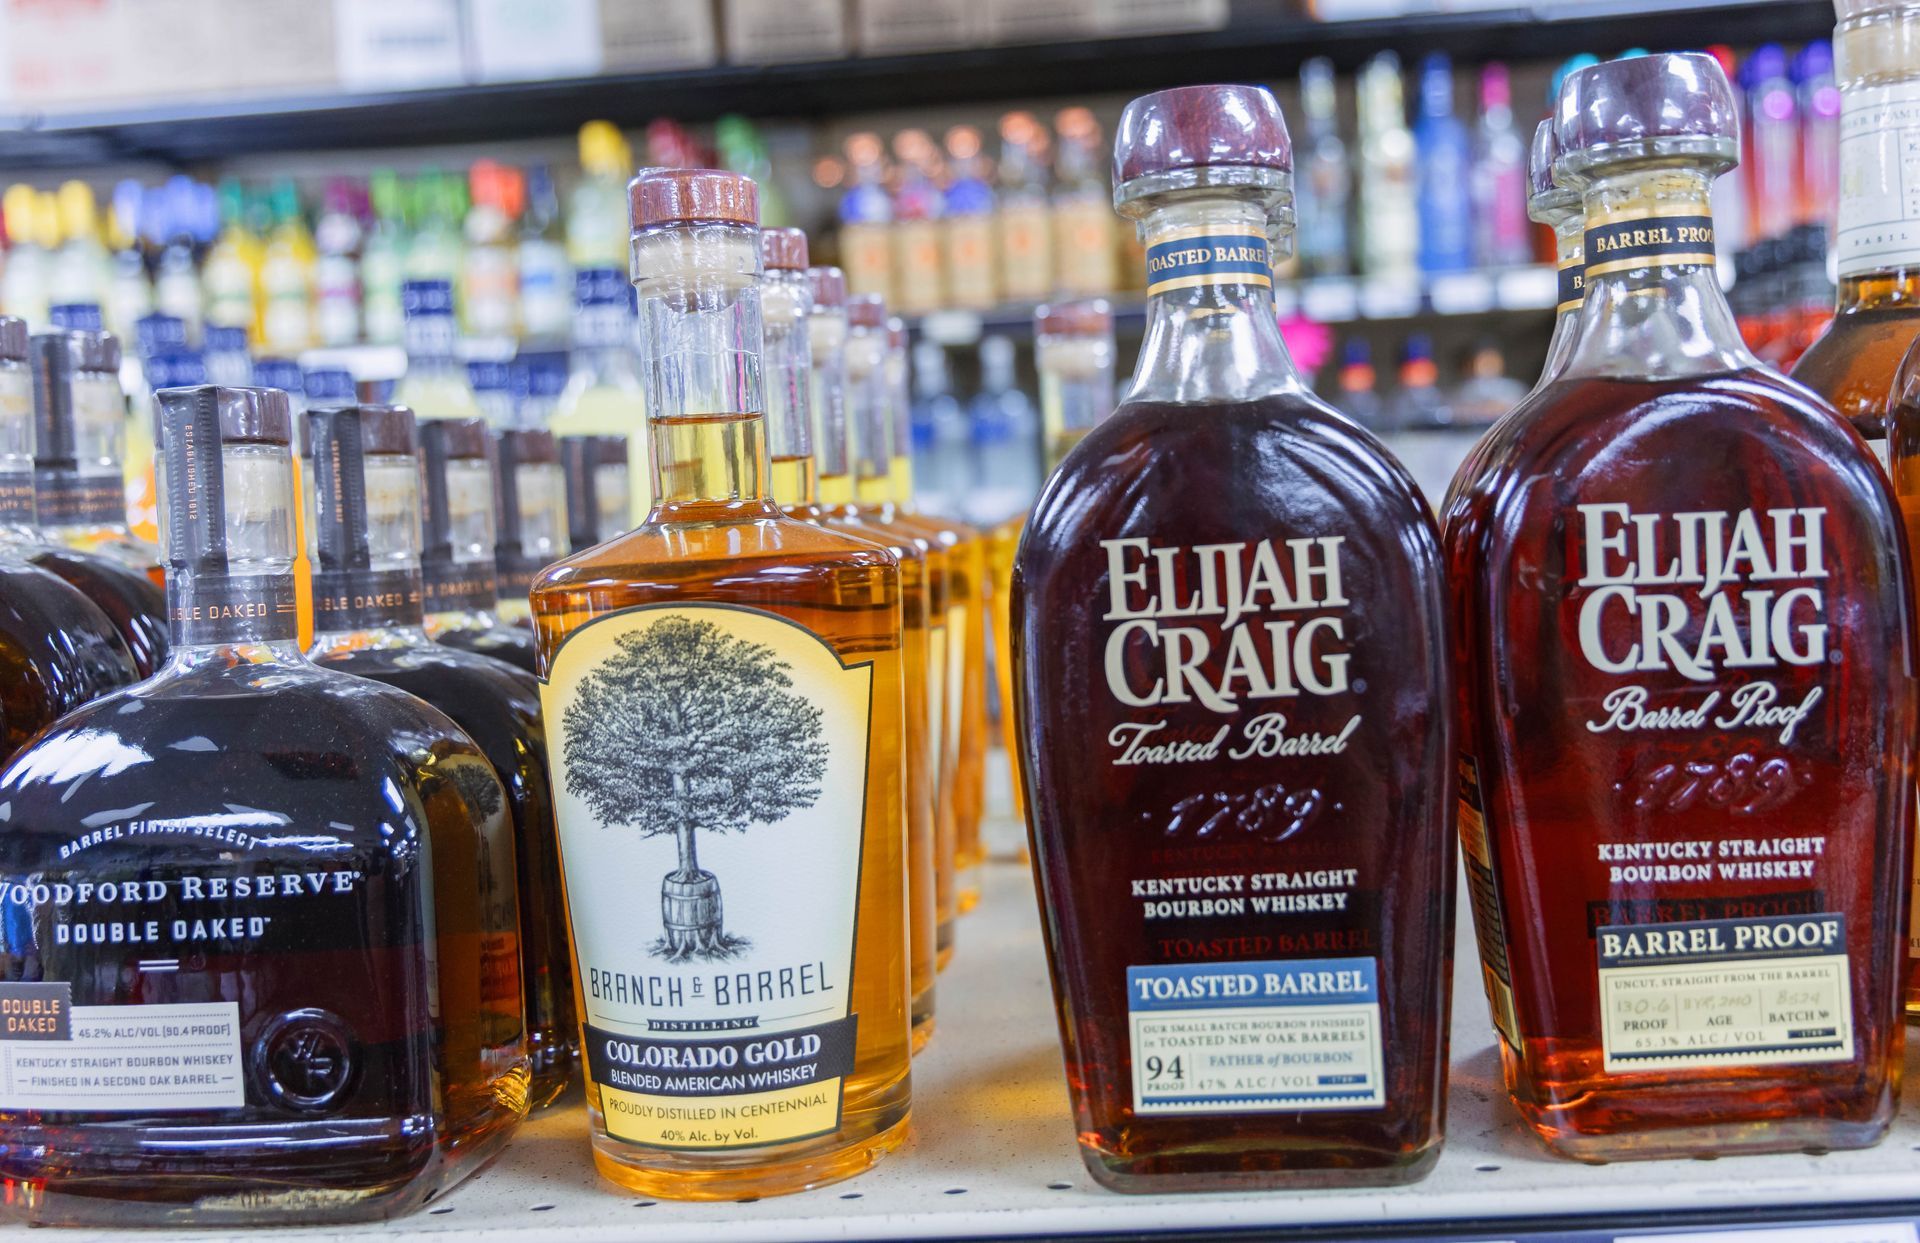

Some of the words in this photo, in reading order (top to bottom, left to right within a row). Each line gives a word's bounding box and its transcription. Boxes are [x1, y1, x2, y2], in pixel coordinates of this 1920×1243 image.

[1596, 227, 1673, 253] BARREL
[1577, 503, 1829, 600] ELIJAH
[1099, 535, 1350, 631] ELIJAH
[208, 603, 267, 619] OAKED
[1578, 585, 1829, 681] CRAIG
[1103, 617, 1351, 713] CRAIG
[1586, 685, 1720, 733] Barrel
[1714, 681, 1822, 745] Proof
[1108, 720, 1231, 765] Toasted
[1228, 712, 1362, 760] Barrel
[59, 825, 124, 860] BARREL
[129, 819, 188, 836] FINISH
[193, 822, 259, 851] SELECT
[1597, 840, 1713, 861] KENTUCKY
[1718, 836, 1825, 857] STRAIGHT
[1131, 874, 1245, 897] KENTUCKY
[1250, 869, 1358, 890] STRAIGHT
[1609, 863, 1712, 883] BOURBON
[1717, 860, 1815, 880] WHISKEY
[1143, 898, 1245, 919] BOURBON
[1250, 893, 1347, 912] WHISKEY
[56, 921, 159, 944] DOUBLE
[1602, 927, 1726, 957] BARREL
[1734, 920, 1839, 950] PROOF
[590, 967, 684, 1007] BRANCH
[691, 976, 704, 995] &
[714, 961, 834, 1006] BARREL
[1135, 973, 1259, 999] TOASTED
[1263, 970, 1369, 995] BARREL
[1614, 979, 1658, 989] UNCUT,
[1661, 975, 1720, 986] STRAIGHT
[1723, 973, 1756, 983] FROM
[1760, 971, 1782, 981] THE
[1786, 969, 1831, 979] BARREL
[2, 999, 61, 1015] DOUBLE
[1768, 1010, 1814, 1023] BATCH
[7, 1017, 57, 1032] OAKED
[78, 1028, 112, 1038] 45.2%
[114, 1027, 161, 1038] ALC/VOL
[652, 1018, 754, 1030] DISTILLING
[1143, 1025, 1168, 1033] OUR
[1170, 1023, 1207, 1032] SMALL
[1210, 1021, 1248, 1031] BATCH
[1251, 1020, 1307, 1030] BOURBON
[1310, 1018, 1365, 1028] FINISHED
[1623, 1019, 1668, 1031] PROOF
[1706, 1015, 1734, 1027] AGE
[1159, 1035, 1225, 1047] TOASTED
[1228, 1033, 1262, 1044] NEW
[1266, 1032, 1297, 1044] OAK
[1301, 1030, 1366, 1043] BARRELS
[16, 1057, 67, 1068] KENTUCKY
[70, 1056, 123, 1067] STRAIGHT
[127, 1055, 180, 1067] BOURBON
[183, 1054, 233, 1065] WHISKEY
[606, 1039, 739, 1069] COLORADO
[744, 1033, 821, 1065] GOLD
[1209, 1054, 1264, 1067] FATHER
[1267, 1052, 1280, 1067] of
[1282, 1051, 1353, 1064] BOURBON
[611, 1070, 661, 1090] BLENDED
[664, 1074, 746, 1091] AMERICAN
[748, 1063, 818, 1087] WHISKEY
[1146, 1055, 1184, 1081] 94
[31, 1076, 78, 1087] FINISHED
[80, 1076, 91, 1087] IN
[93, 1076, 101, 1086] A
[103, 1075, 146, 1086] SECOND
[149, 1075, 171, 1085] OAK
[174, 1074, 218, 1084] BARREL
[1147, 1082, 1185, 1091] PROOF
[609, 1097, 653, 1118] PROUDLY
[657, 1106, 716, 1120] DISTILLED
[720, 1106, 736, 1118] IN
[740, 1093, 828, 1118] CENTENNIAL
[660, 1130, 686, 1141] 40%
[688, 1130, 711, 1141] Alc.
[714, 1129, 729, 1143] by
[733, 1128, 758, 1140] Vol.
